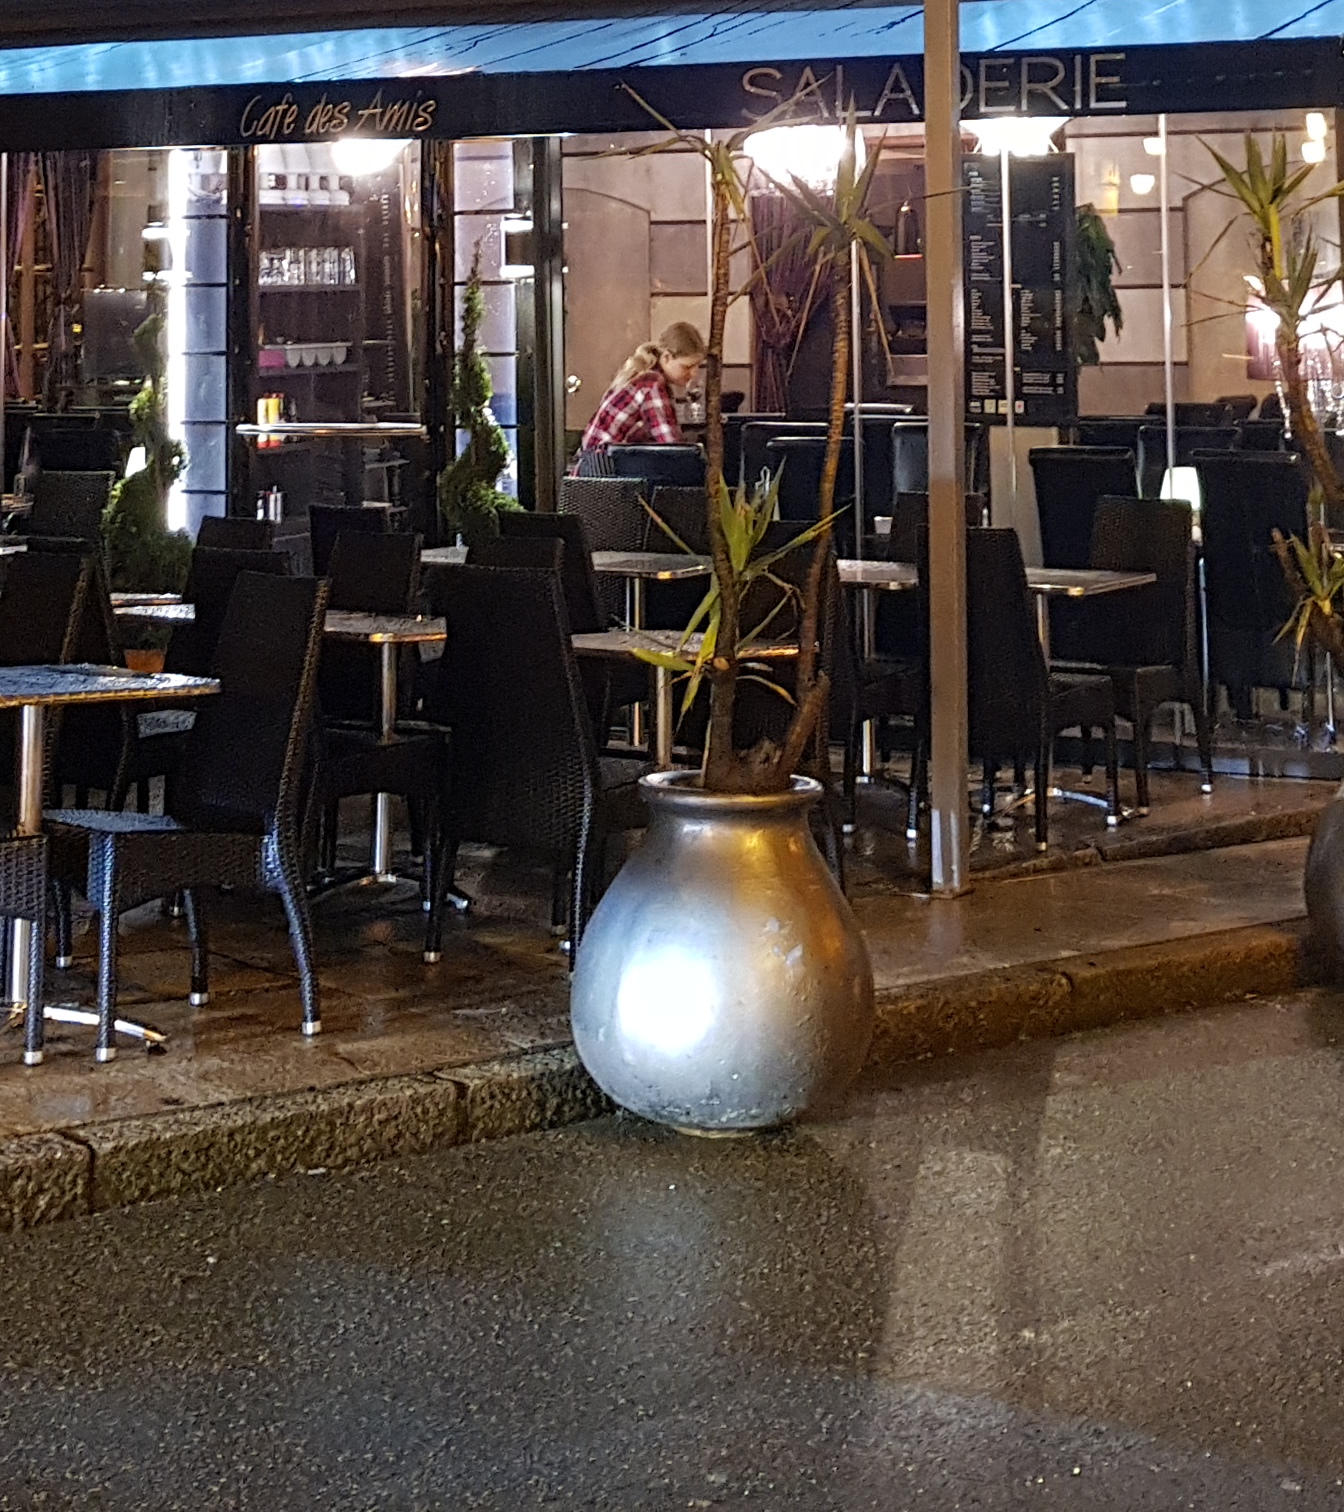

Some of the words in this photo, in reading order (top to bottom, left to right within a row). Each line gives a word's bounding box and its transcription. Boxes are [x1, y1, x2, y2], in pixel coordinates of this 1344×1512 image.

[239, 92, 299, 140] Cafe
[304, 91, 352, 135] des
[354, 88, 437, 133] Amis
